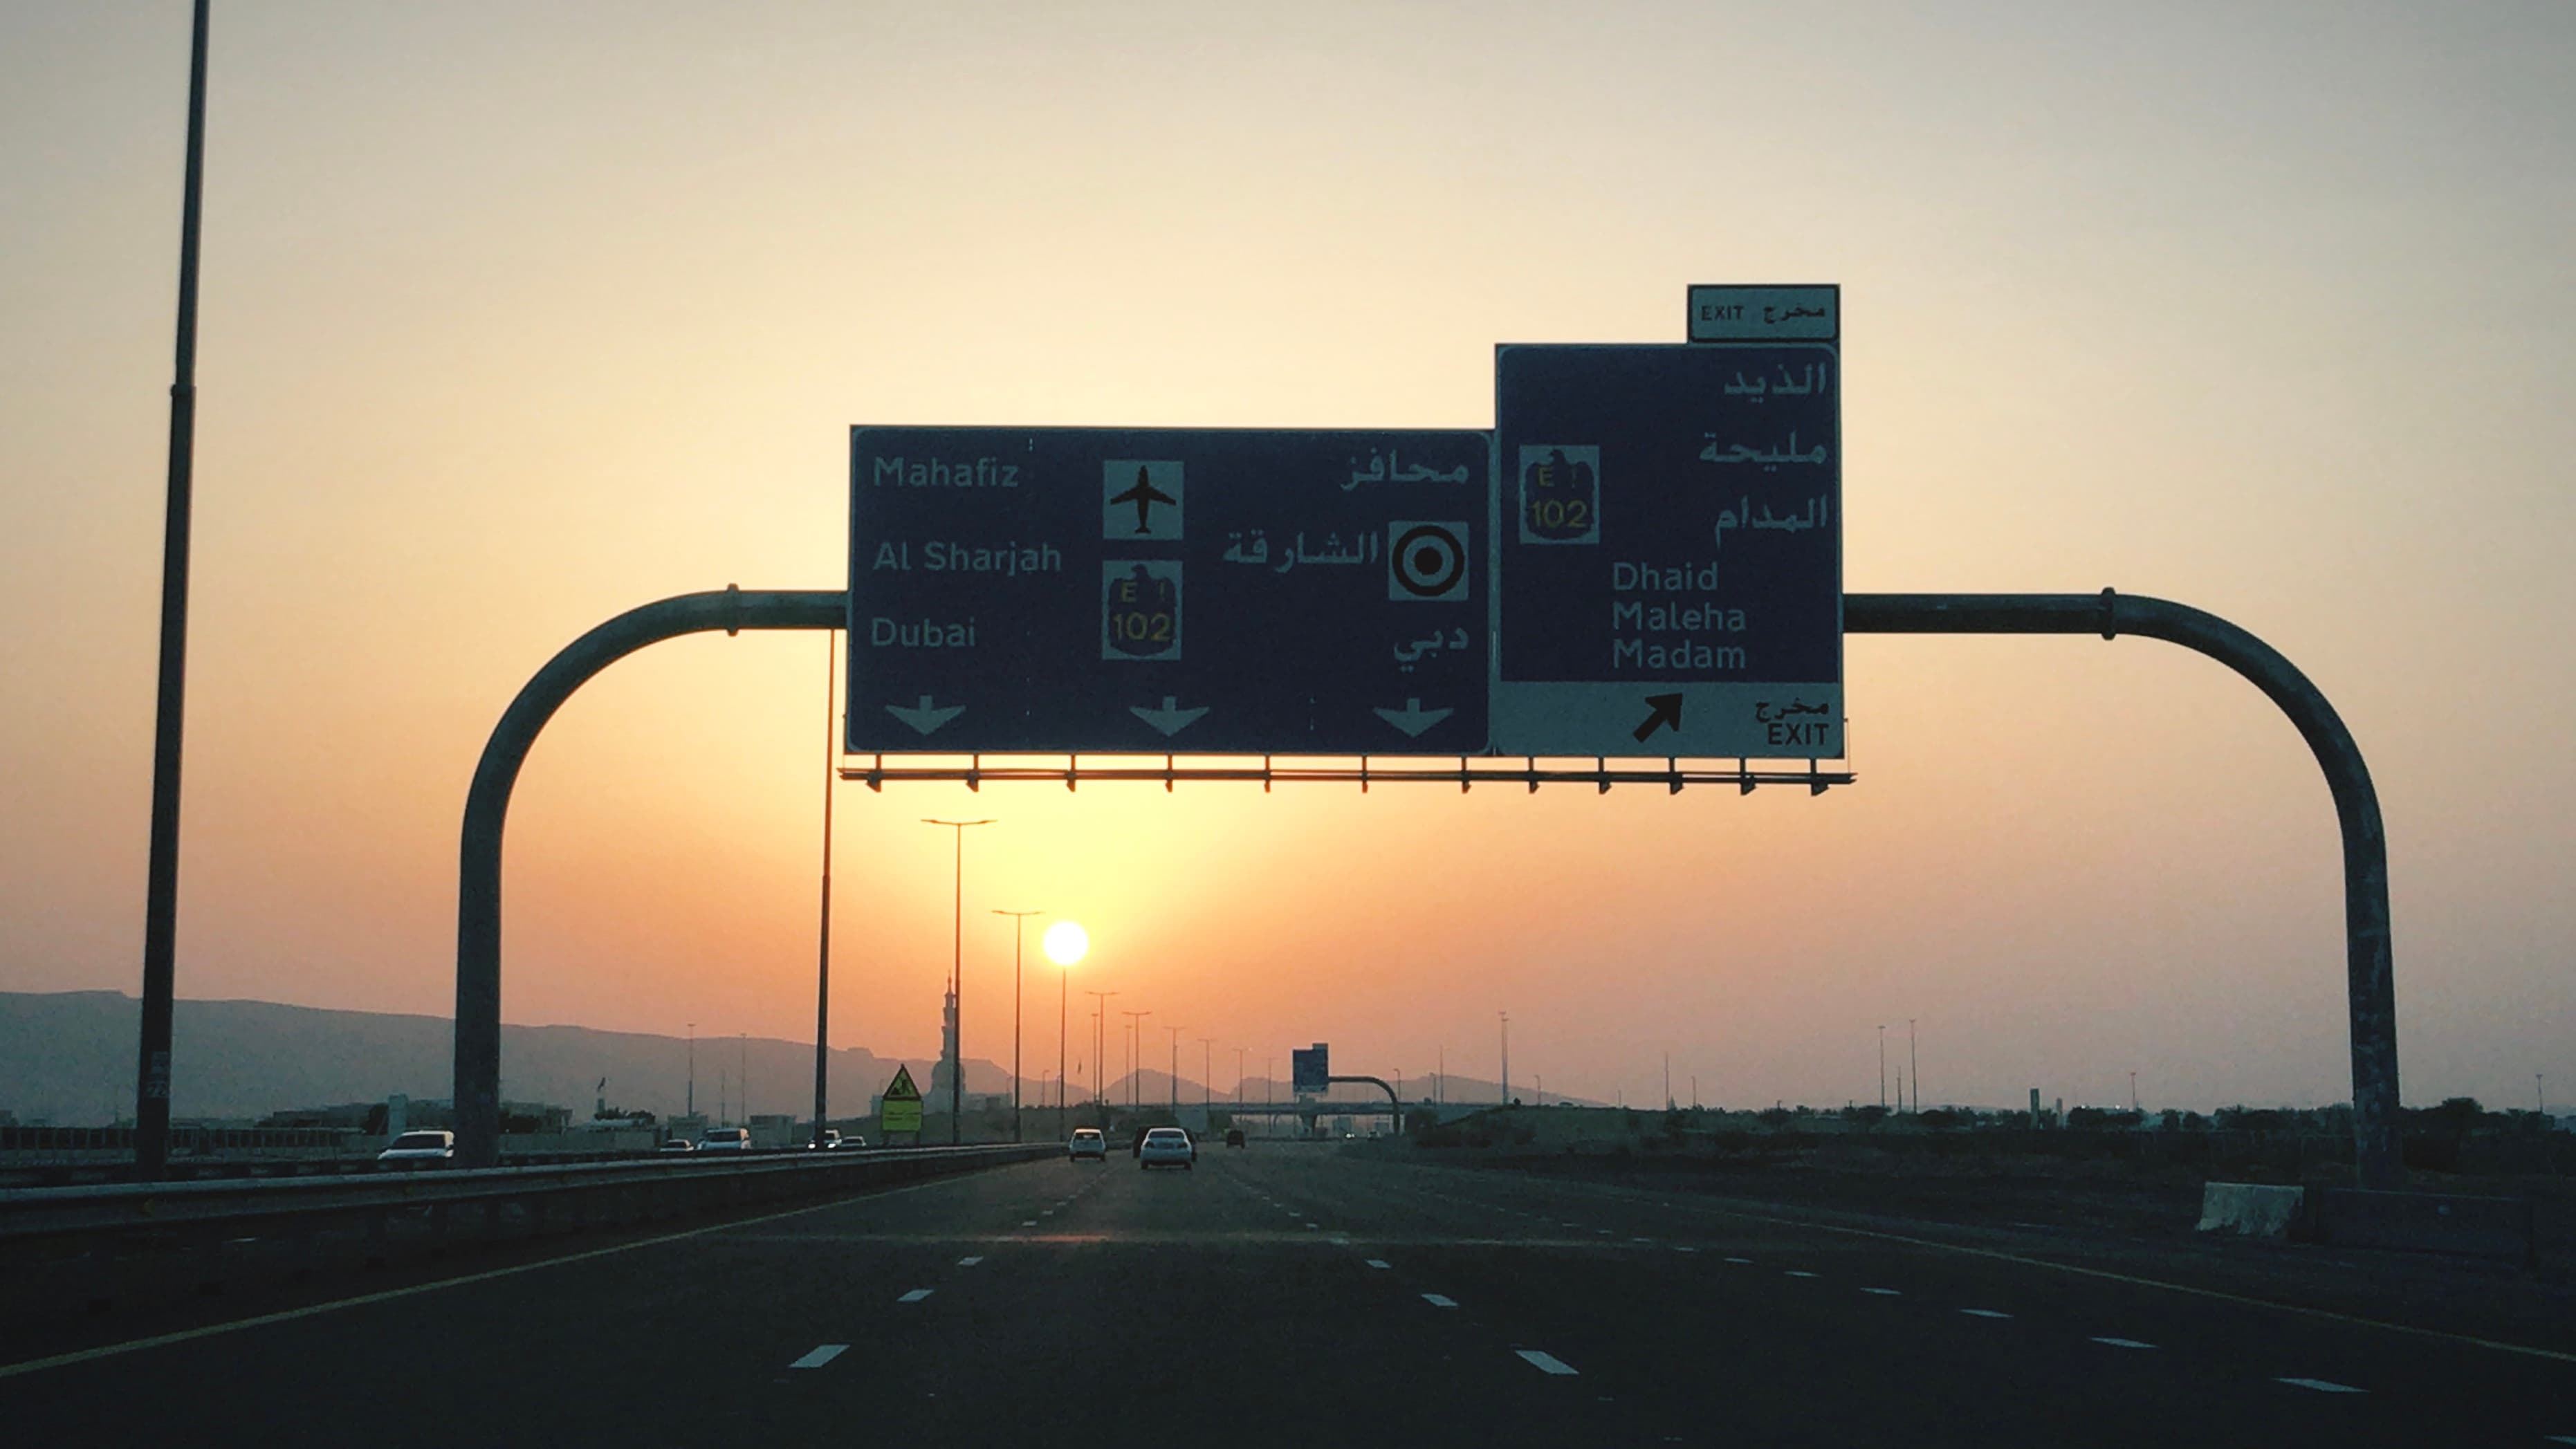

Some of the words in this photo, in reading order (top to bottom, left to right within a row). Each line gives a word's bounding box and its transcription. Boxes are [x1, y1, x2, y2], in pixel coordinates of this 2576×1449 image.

[1701, 306, 1744, 320] EXIT
[1763, 304, 1826, 324] مخرج
[1724, 362, 1827, 403] الذيد
[1699, 431, 1827, 472] مليحة
[874, 457, 1019, 486] Mahafiz
[1341, 448, 1469, 491] محافز
[1538, 466, 1554, 487] E
[1532, 500, 1588, 528] 102
[1715, 495, 1827, 548] المدام
[873, 542, 910, 571] Al
[925, 541, 1061, 576] Sharjah
[1222, 529, 1379, 573] الشارقة
[1613, 562, 1718, 591] Dhaid
[1121, 582, 1137, 602] E
[1113, 611, 1170, 641] 102
[1613, 602, 1746, 631] Maleha
[872, 617, 975, 647] Dubai
[1393, 627, 1469, 672] دبي
[1613, 638, 1746, 669] Madam
[1756, 697, 1830, 723] مخرج
[1767, 724, 1829, 745] EXIT
